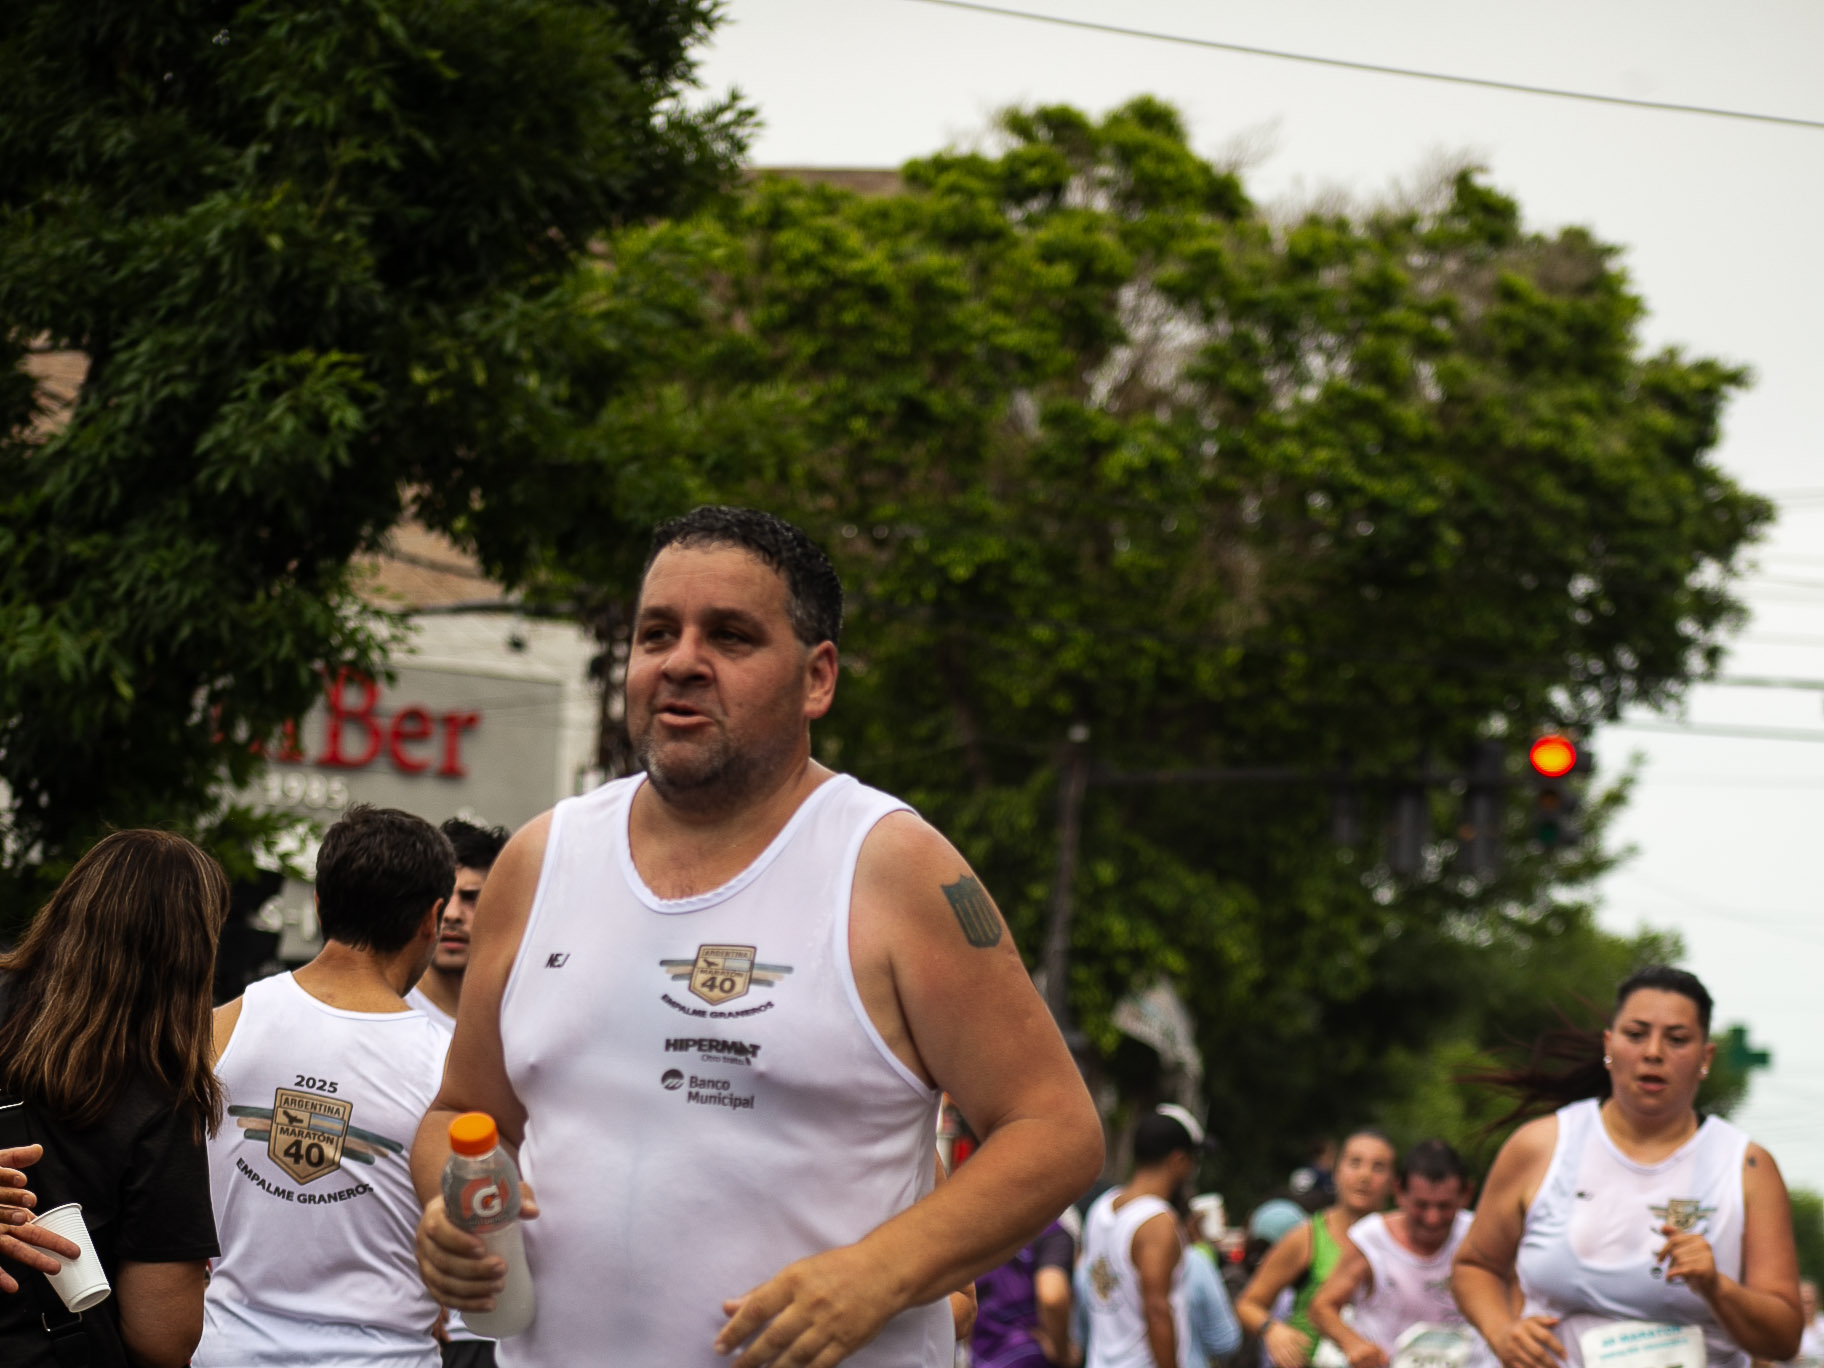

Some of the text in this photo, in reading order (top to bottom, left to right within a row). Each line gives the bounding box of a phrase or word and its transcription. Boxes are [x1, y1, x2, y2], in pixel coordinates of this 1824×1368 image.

[701, 976, 736, 994] 40
[661, 994, 774, 1019] EMPALME GRANEROS
[294, 1074, 339, 1094] 2025
[689, 1075, 731, 1091] Banco
[283, 1096, 341, 1118] ARGENTINA
[687, 1091, 755, 1110] Municipal
[283, 1139, 325, 1168] 40
[236, 1157, 295, 1202] EMPALME
[472, 1184, 503, 1218] G
